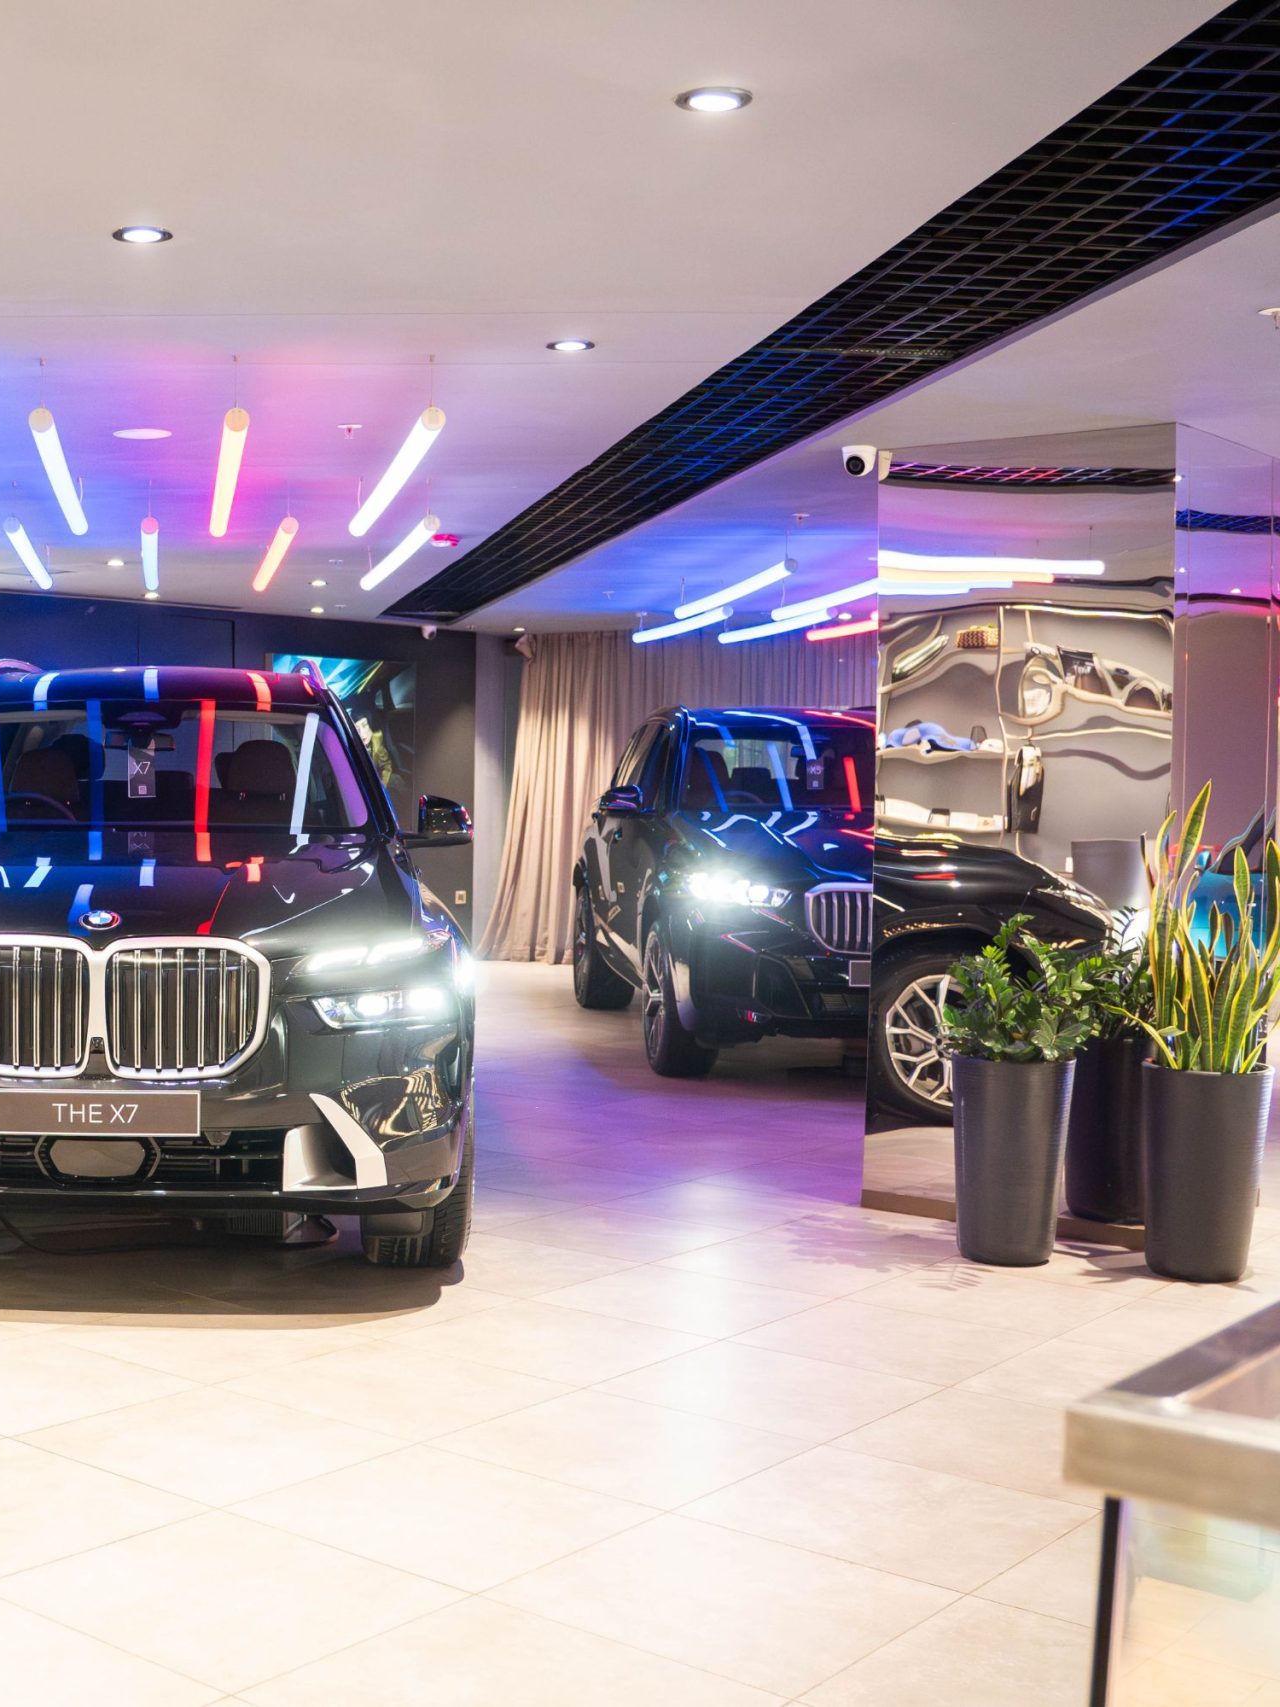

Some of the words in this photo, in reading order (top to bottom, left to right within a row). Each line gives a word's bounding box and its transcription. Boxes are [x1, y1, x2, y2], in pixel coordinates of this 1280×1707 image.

[133, 761, 151, 775] X7
[52, 1103, 103, 1123] THE
[110, 1104, 138, 1123] X7
